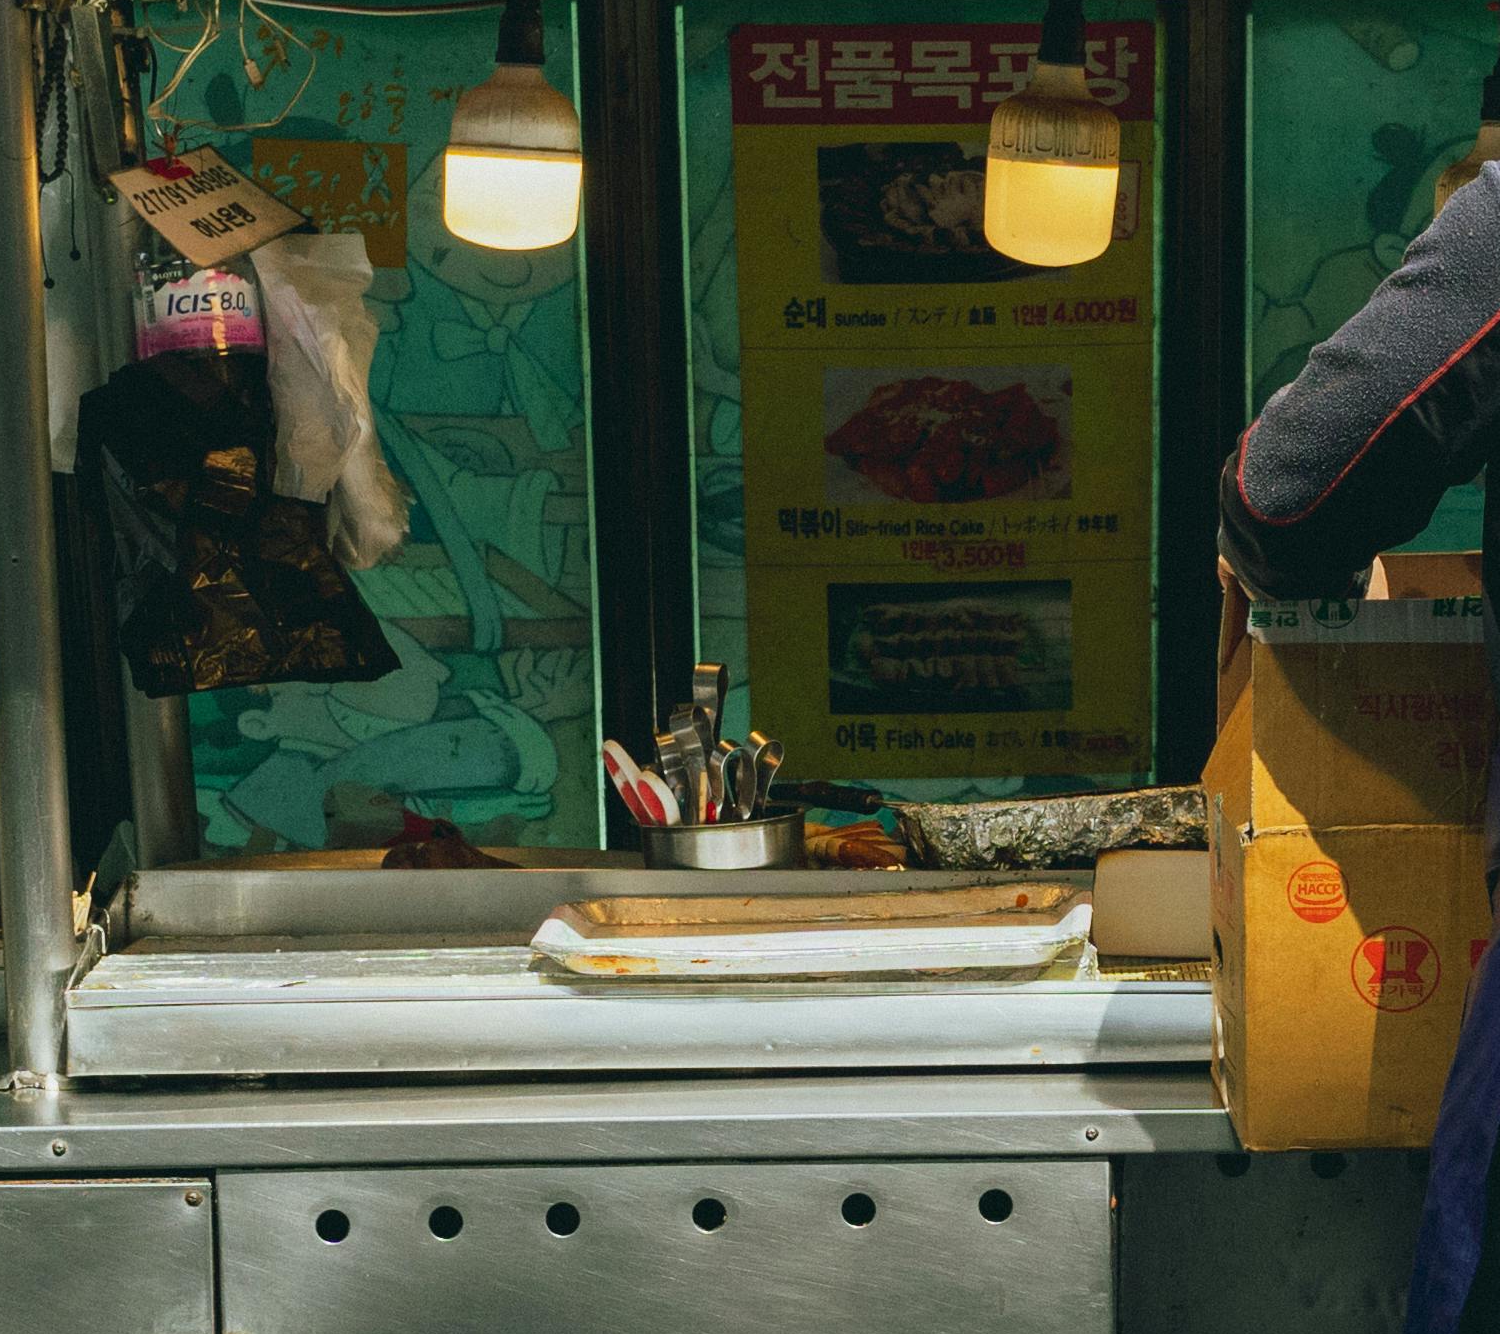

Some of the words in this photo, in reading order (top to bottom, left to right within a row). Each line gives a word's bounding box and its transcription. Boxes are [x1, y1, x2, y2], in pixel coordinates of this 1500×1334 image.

[220, 291, 246, 312] 8.0
[783, 297, 826, 329] 순대
[834, 310, 887, 328] sundae
[778, 508, 841, 539] 떡볶이
[915, 518, 947, 534] Rice
[950, 518, 984, 536] Cake
[836, 723, 877, 752] 어묵
[885, 729, 924, 749] Fish
[929, 728, 977, 750] Cake
[1297, 883, 1342, 896] HACCP
